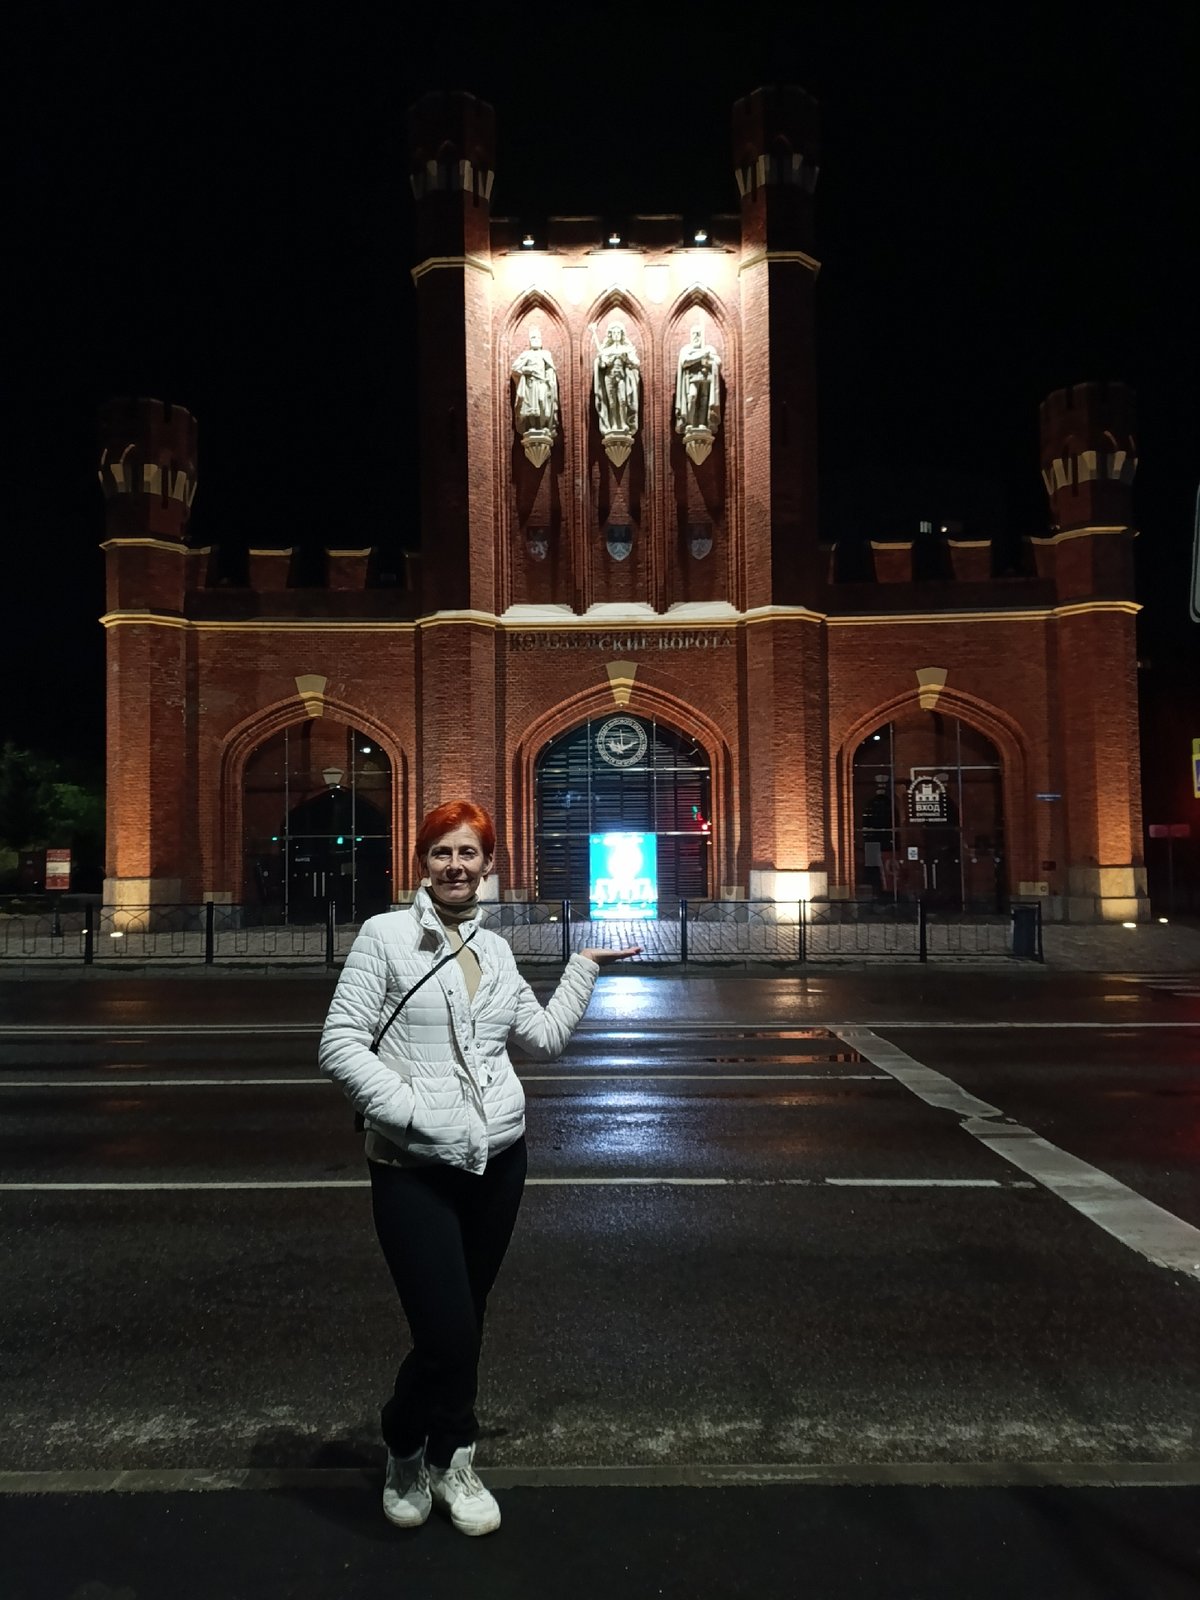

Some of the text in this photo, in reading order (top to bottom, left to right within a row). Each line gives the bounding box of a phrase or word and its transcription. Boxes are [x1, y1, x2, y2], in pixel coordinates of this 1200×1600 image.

[510, 633, 731, 651] КОСКИЕ ВОРОТА
[916, 804, 940, 812] ВХОД
